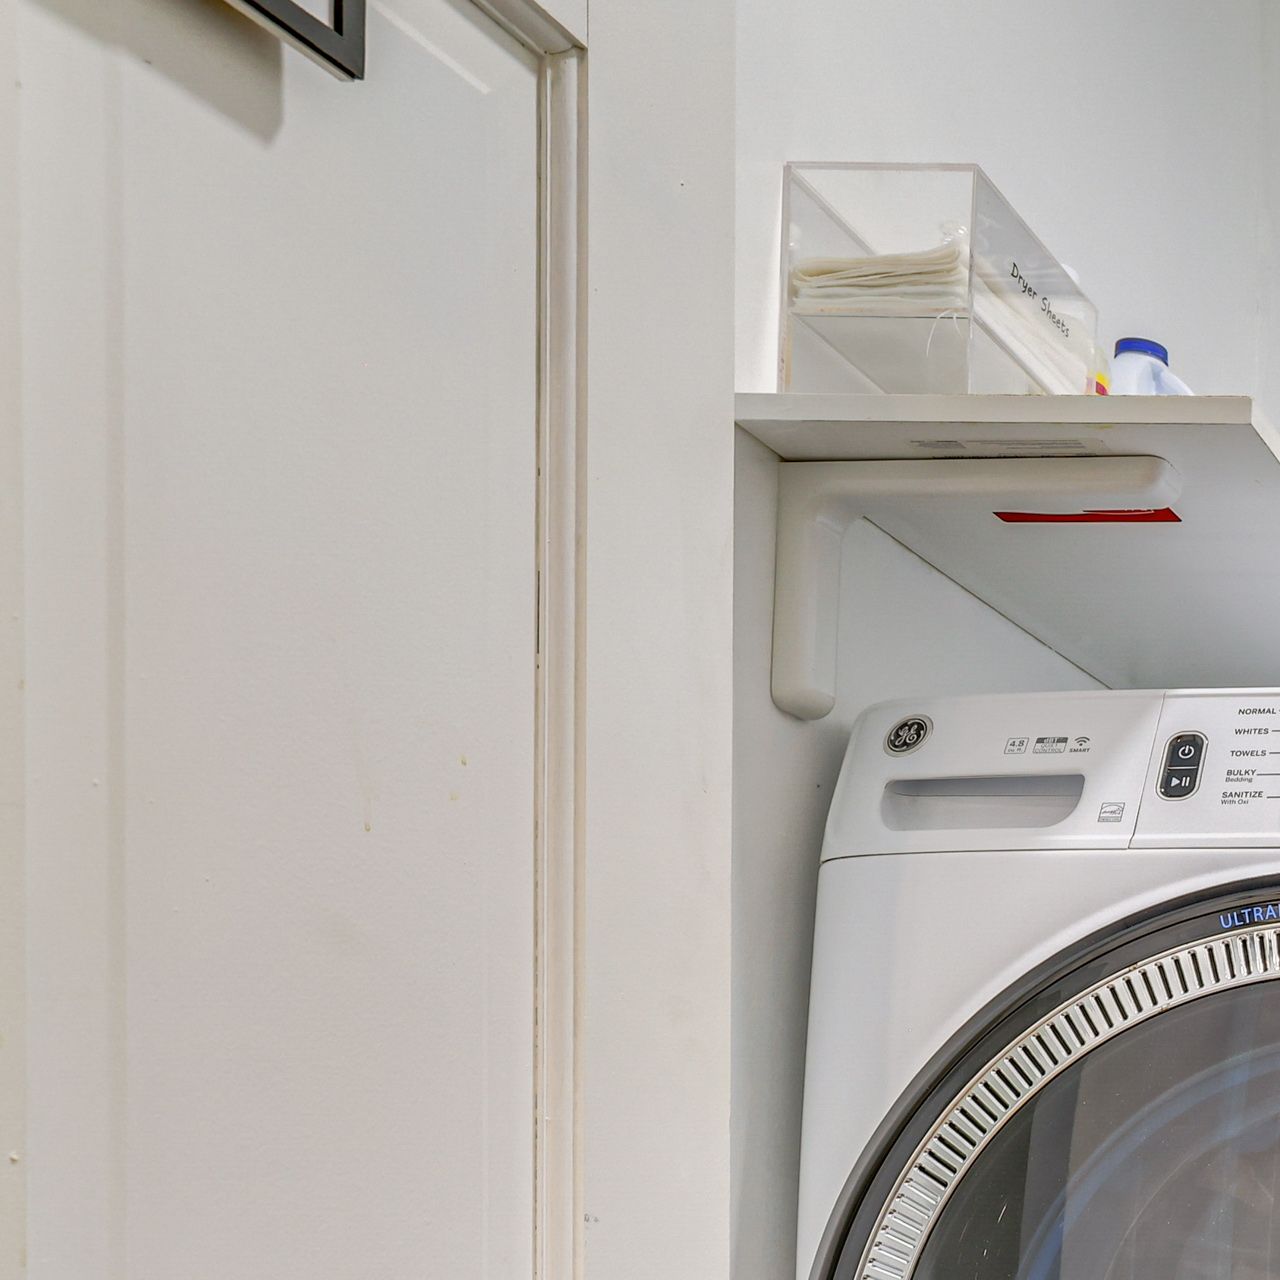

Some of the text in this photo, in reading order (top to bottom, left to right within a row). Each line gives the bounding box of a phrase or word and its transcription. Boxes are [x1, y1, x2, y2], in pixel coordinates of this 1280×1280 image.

[1010, 262, 1069, 338] Dryer Sheets
[1234, 727, 1269, 735] WHITES
[1230, 749, 1267, 757] TOWELS
[1226, 768, 1257, 776] BULKY
[1221, 790, 1264, 799] SANITIZE
